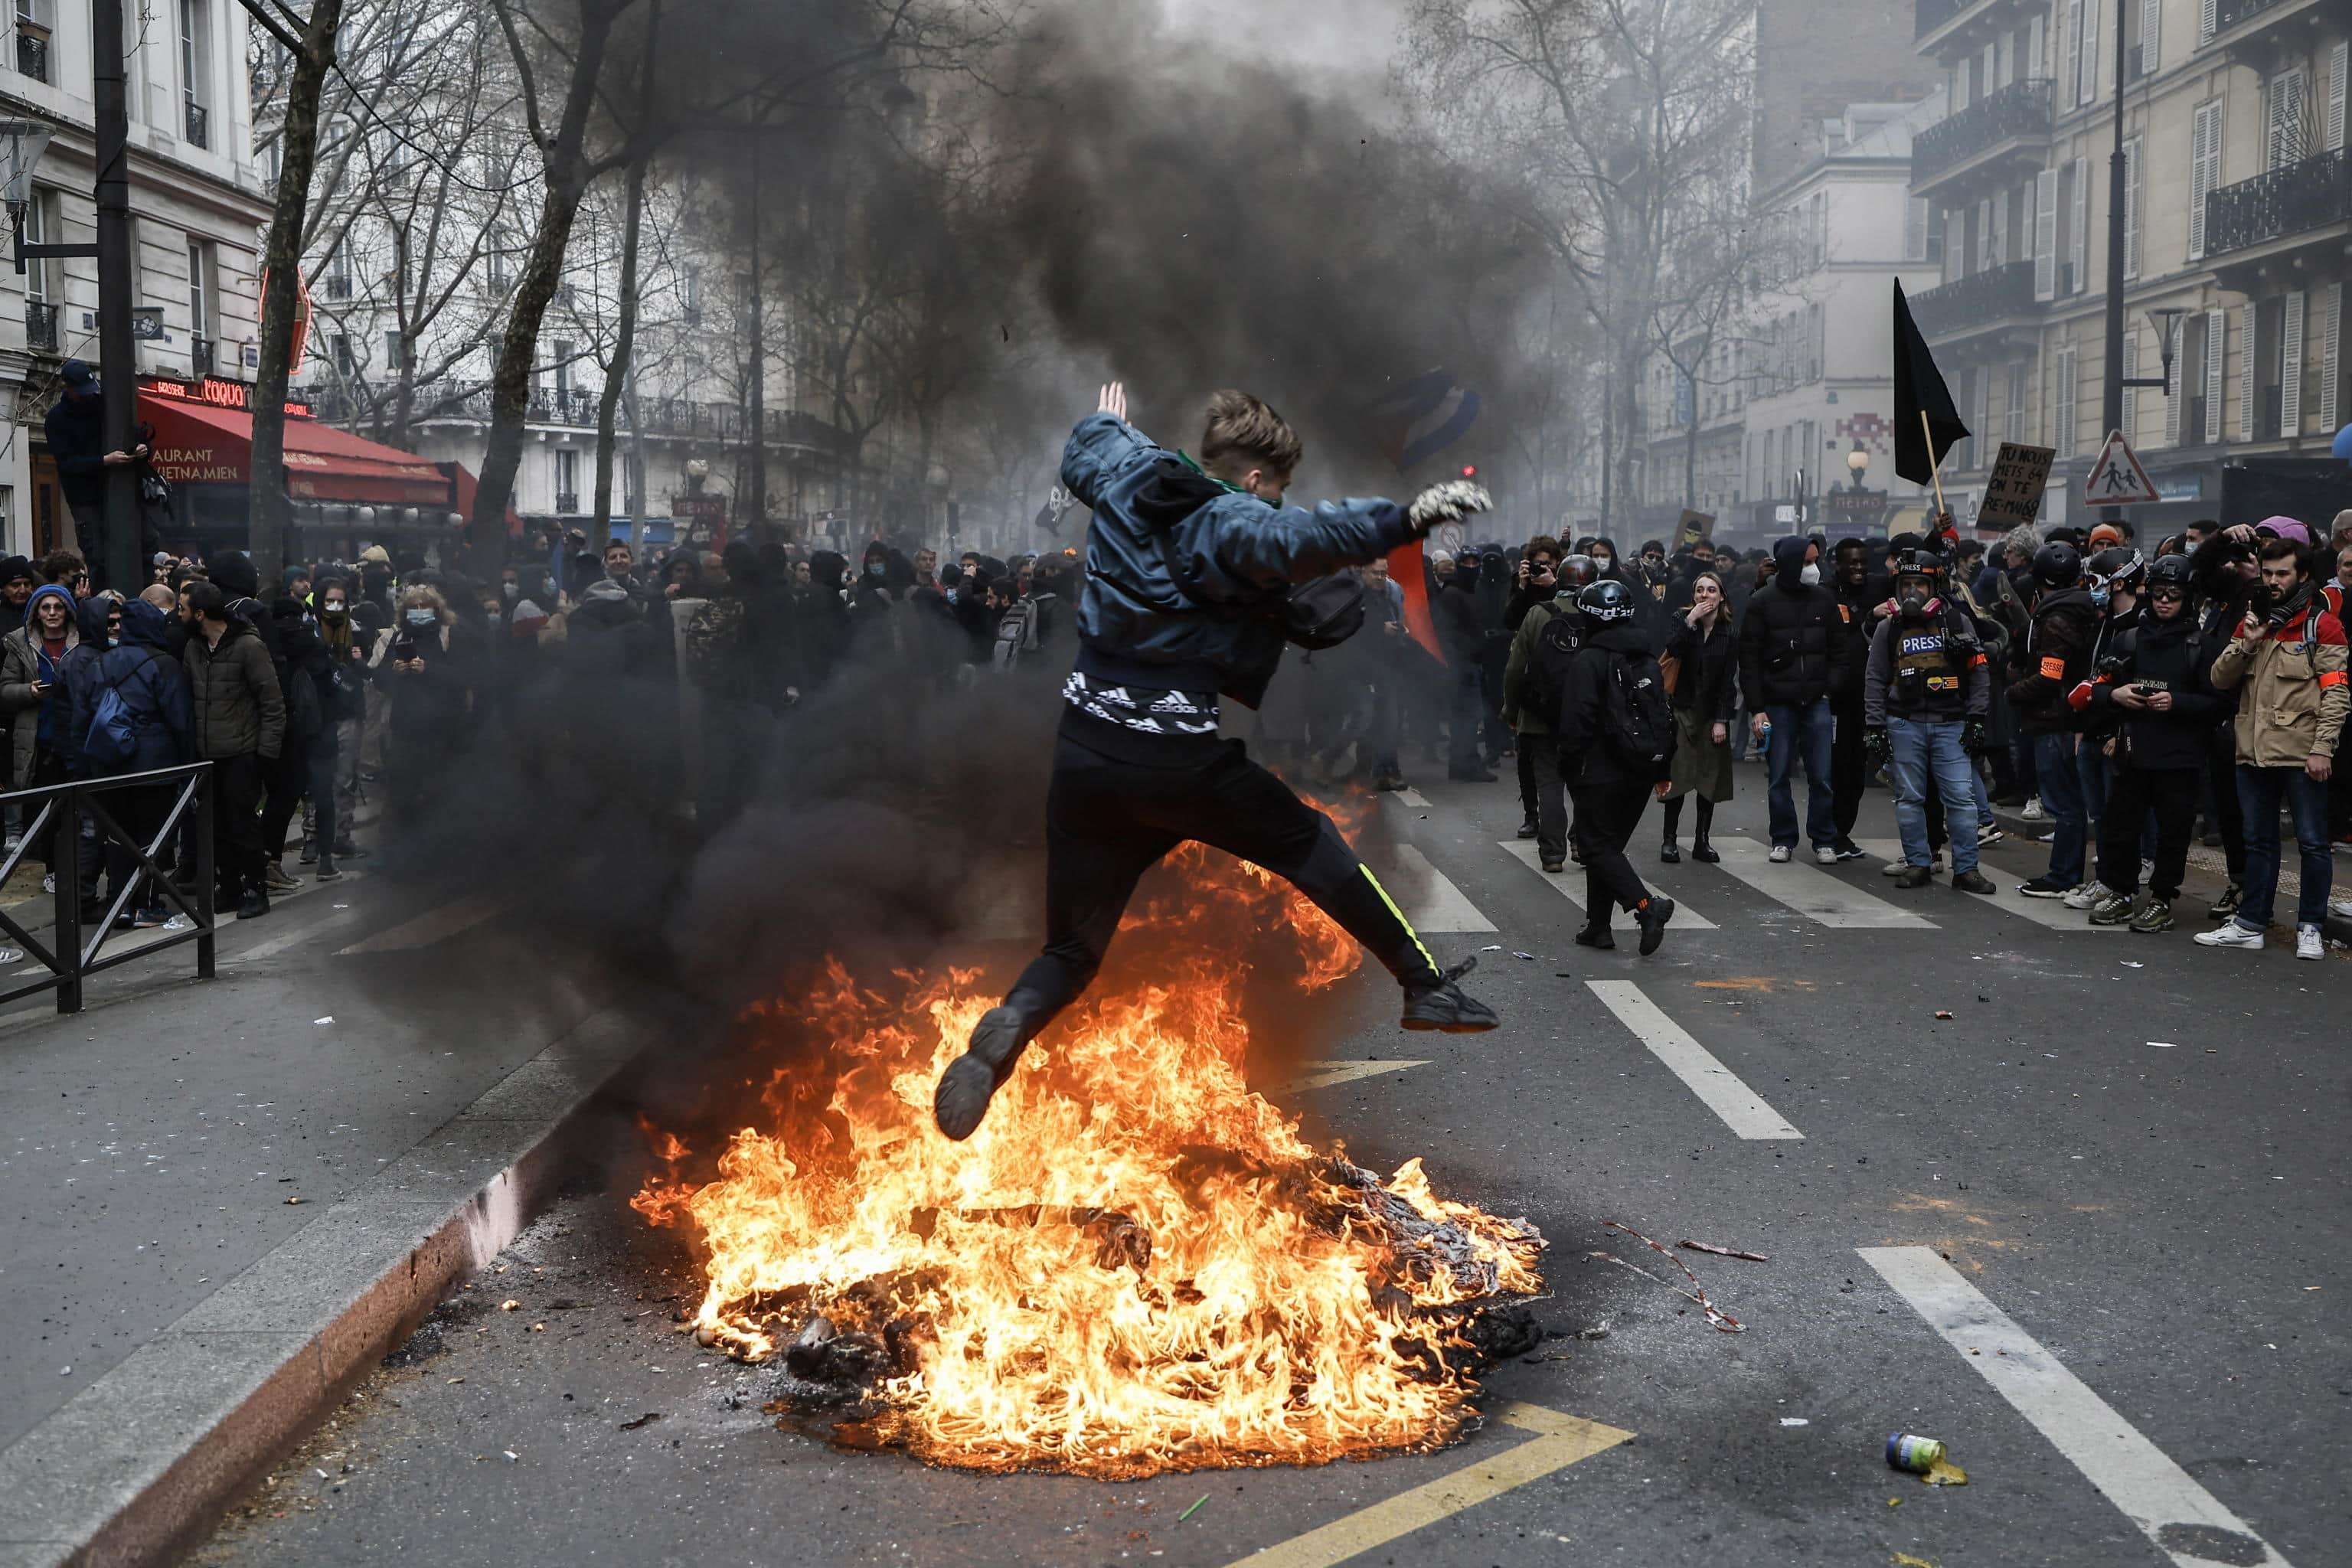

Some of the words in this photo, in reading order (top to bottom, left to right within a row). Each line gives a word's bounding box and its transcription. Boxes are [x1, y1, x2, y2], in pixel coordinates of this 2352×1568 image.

[153, 449, 213, 462] AURANT
[2014, 481, 2031, 494] TE
[1903, 635, 1942, 652] PRESS
